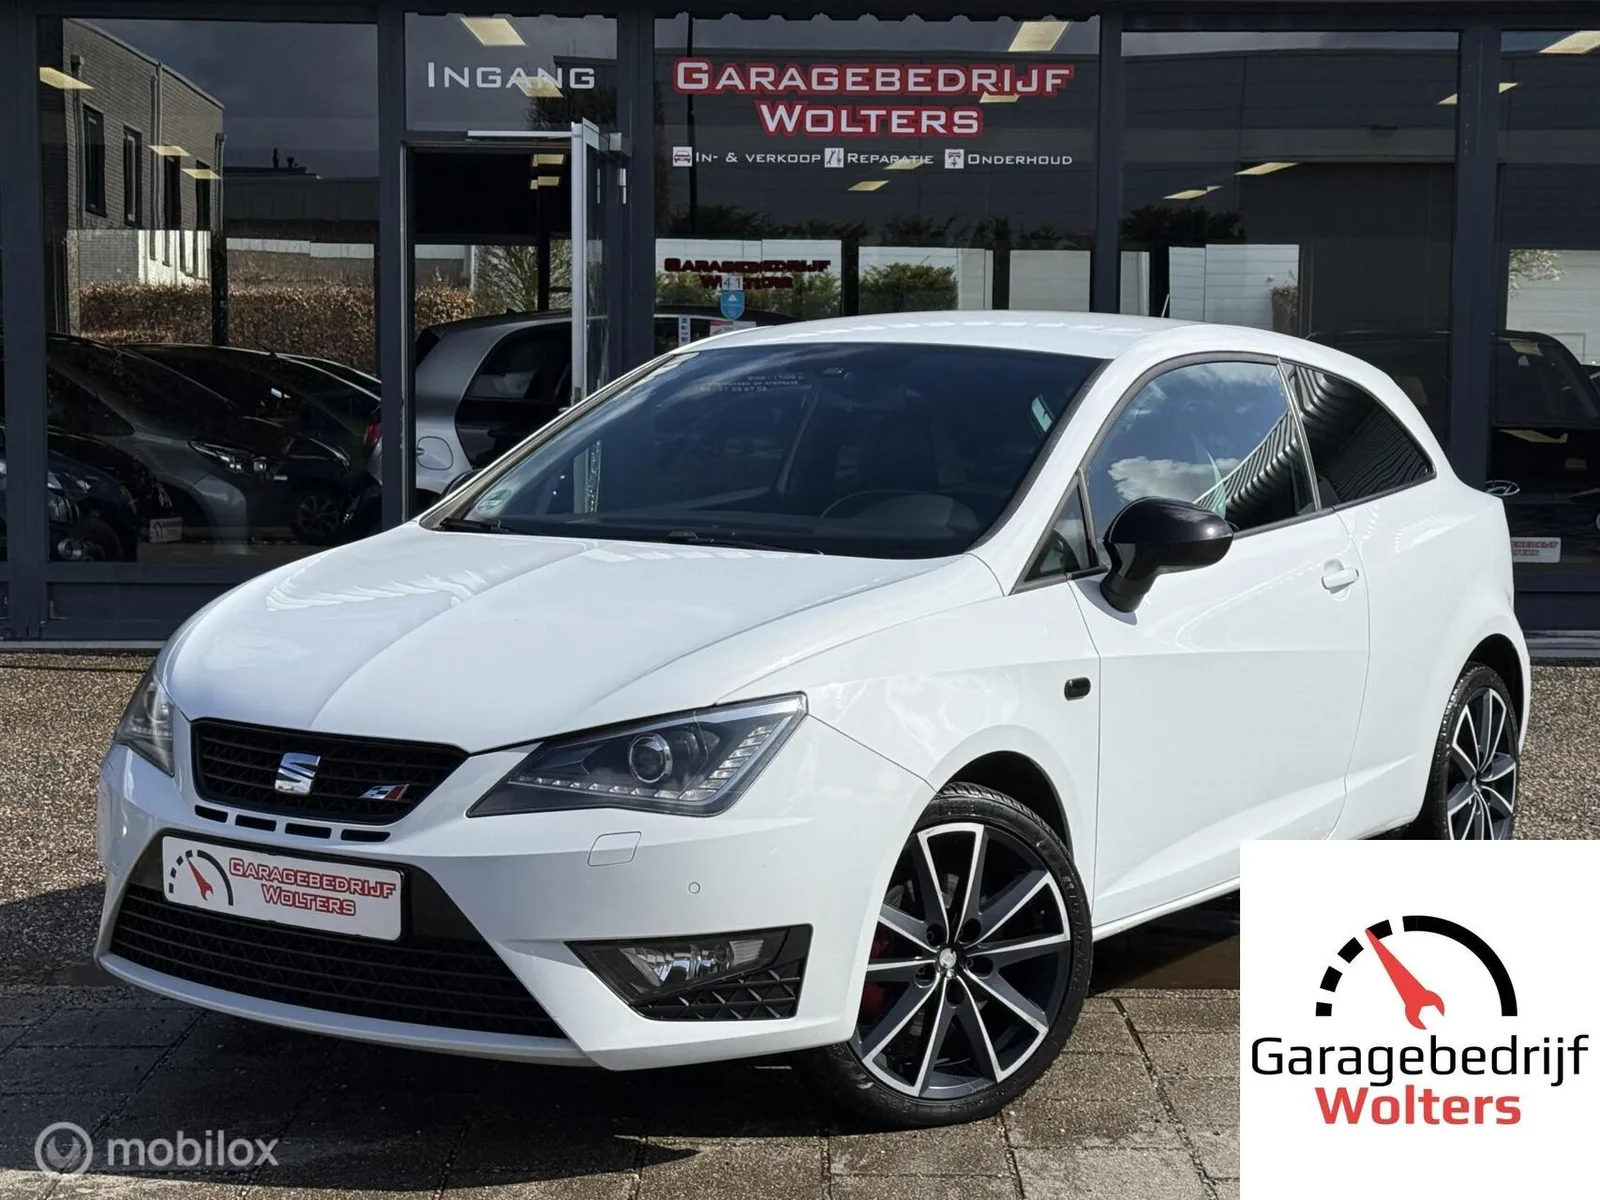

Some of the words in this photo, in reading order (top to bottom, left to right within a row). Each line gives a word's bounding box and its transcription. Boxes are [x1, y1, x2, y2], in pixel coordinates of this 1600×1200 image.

[427, 62, 595, 89] INGANG
[674, 58, 1074, 96] GARAGEBEDRIJF
[754, 100, 983, 138] WOLTERS
[725, 152, 738, 163] &
[745, 153, 821, 164] VERKOOP
[847, 153, 934, 165] REPARATIE
[967, 154, 1073, 166] ONDERHOUD
[229, 857, 396, 899] GARAGEBEDRIJF
[261, 883, 356, 916] WOLTERS
